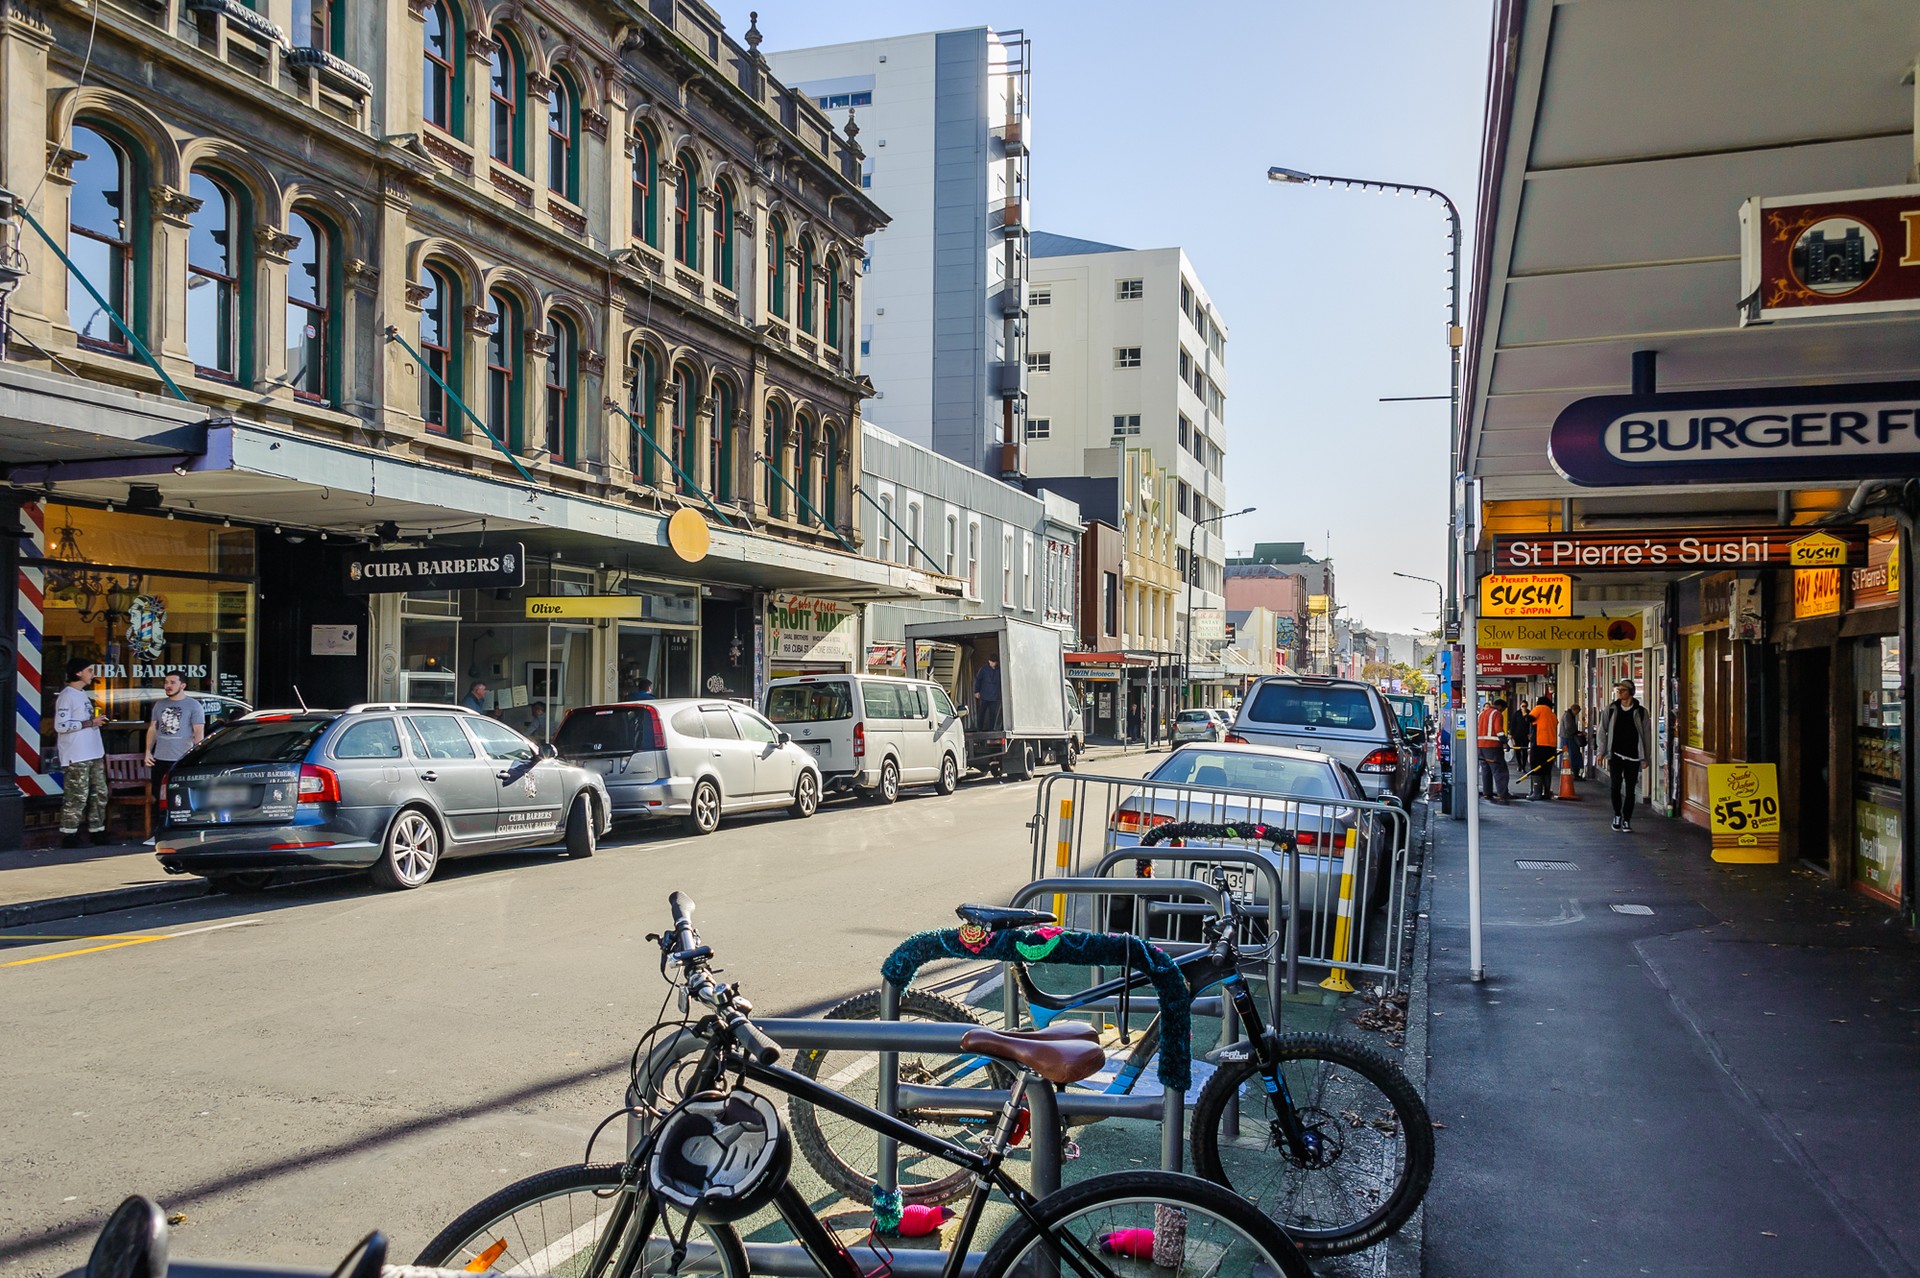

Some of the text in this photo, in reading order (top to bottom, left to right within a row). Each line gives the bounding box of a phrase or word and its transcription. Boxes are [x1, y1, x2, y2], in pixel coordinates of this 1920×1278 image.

[1620, 408, 1920, 454] BURGER F
[1509, 536, 1769, 567] St Pierre’s Sushi
[1797, 547, 1840, 560] SUSHI
[364, 557, 499, 577] CUBA BARBERS
[1796, 573, 1811, 605] SOY
[1851, 571, 1860, 591] St
[1490, 584, 1563, 606] SUSHI
[531, 603, 563, 614] Olive.
[1520, 607, 1551, 615] JAPAN
[770, 607, 852, 633] FRUIT MART
[1483, 625, 1604, 641] Slow Boat Records
[792, 645, 804, 653] CUBA
[1505, 654, 1546, 662] Westpac
[267, 770, 296, 778] BARBERS
[508, 811, 552, 822] CUBA BARBERS
[1714, 796, 1777, 830] $5.70
[498, 821, 559, 833] COURTENAY BARBERS
[1751, 819, 1759, 829] 8
[1860, 832, 1887, 870] healthy
